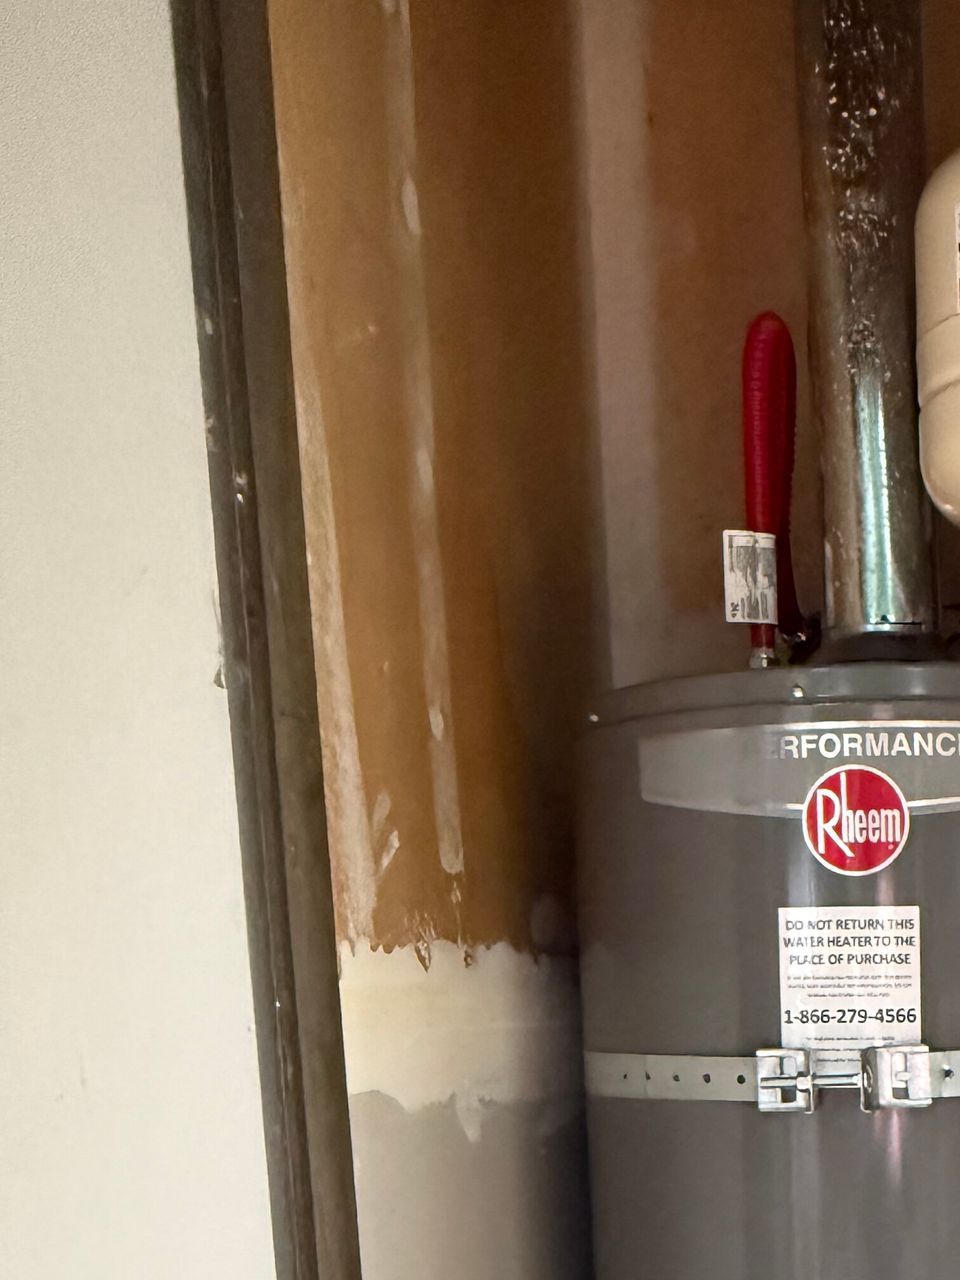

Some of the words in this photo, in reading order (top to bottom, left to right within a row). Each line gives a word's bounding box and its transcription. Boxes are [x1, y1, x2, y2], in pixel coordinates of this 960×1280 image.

[815, 771, 901, 858] Rheem
[785, 919, 804, 931] DO
[807, 919, 833, 931] NOT
[835, 918, 884, 931] RETURN
[887, 918, 915, 931] THIS
[783, 936, 824, 948] WATER
[827, 936, 872, 948] HEATER
[875, 935, 891, 948] TO
[893, 936, 916, 947] THE
[789, 954, 826, 966] PLACE
[828, 953, 844, 965] OF
[846, 953, 912, 965] PURCHASE
[783, 1008, 917, 1025] 1-866-279-4566
